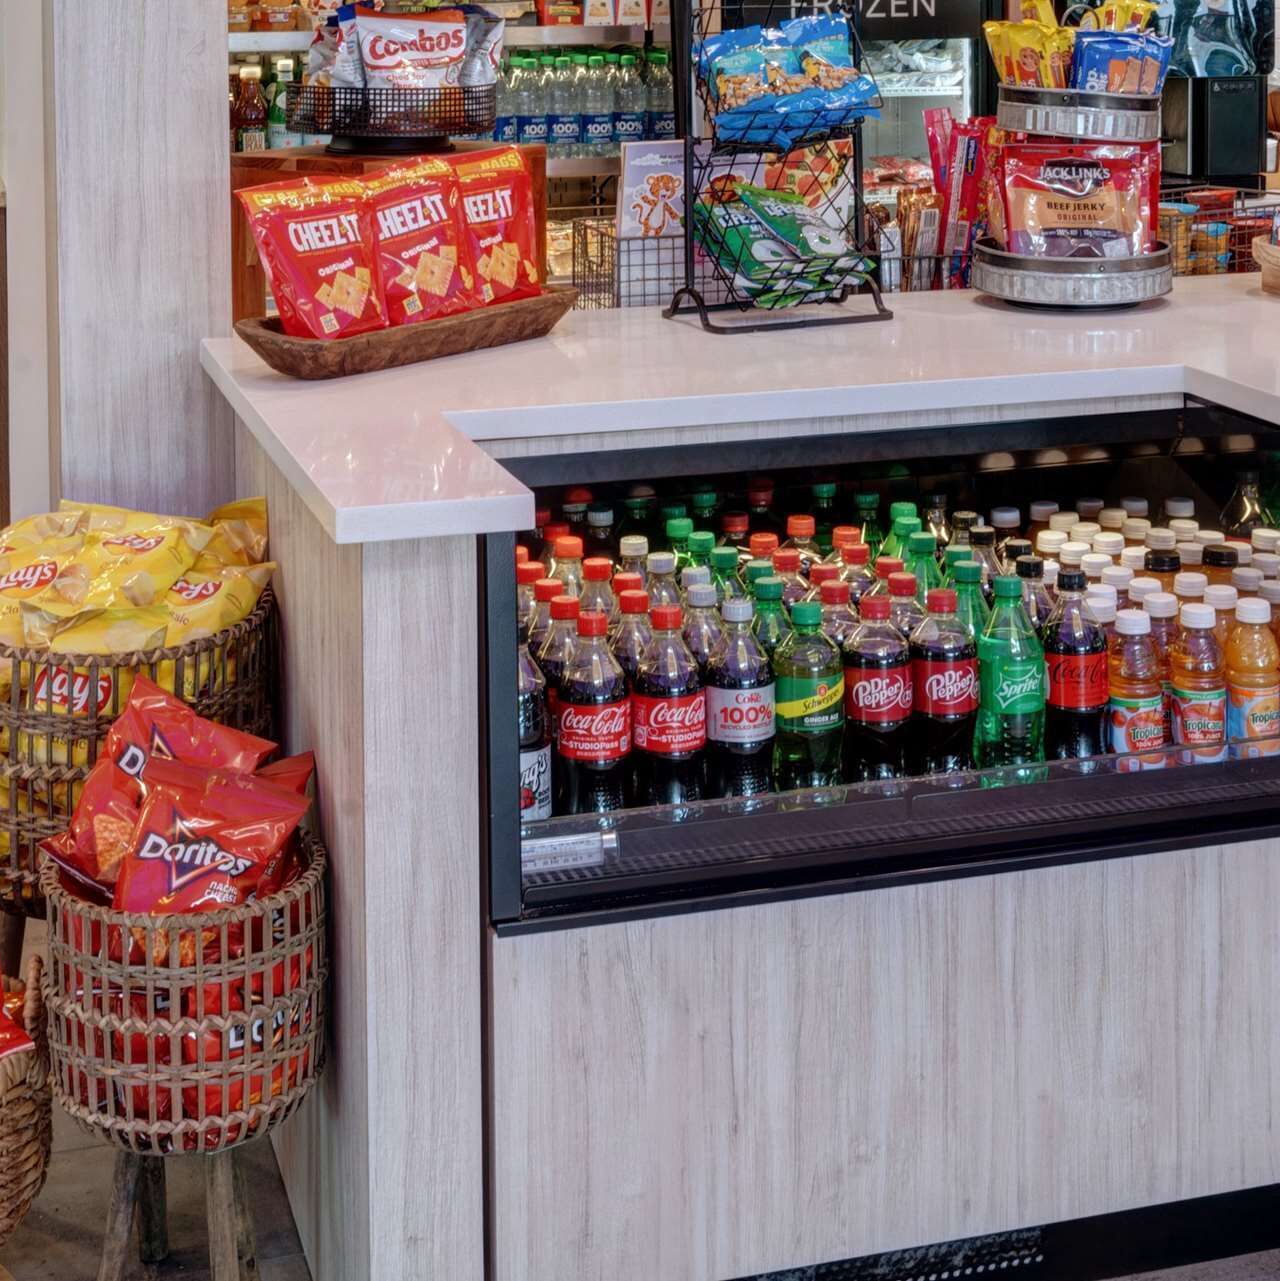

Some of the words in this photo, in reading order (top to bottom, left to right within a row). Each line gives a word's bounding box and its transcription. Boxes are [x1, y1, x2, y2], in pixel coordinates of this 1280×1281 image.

[369, 28, 465, 61] Combos
[479, 151, 519, 170] BAGS
[1038, 166, 1070, 179] JACK
[1046, 201, 1072, 211] BEEF
[1073, 202, 1106, 212] JERKY
[376, 193, 448, 241] HEEZ-IT
[1056, 213, 1098, 221] ORIGINAL
[871, 677, 890, 692] Dr
[928, 674, 972, 701] Pepper
[944, 670, 963, 686] Dr
[856, 680, 901, 709] Pepper
[999, 678, 1040, 698] Sprite
[735, 692, 762, 705] Coke
[561, 704, 626, 736] Coca-Cola
[720, 704, 771, 723] 100%
[1250, 711, 1280, 725] Tropica
[139, 832, 253, 876] Doritos
